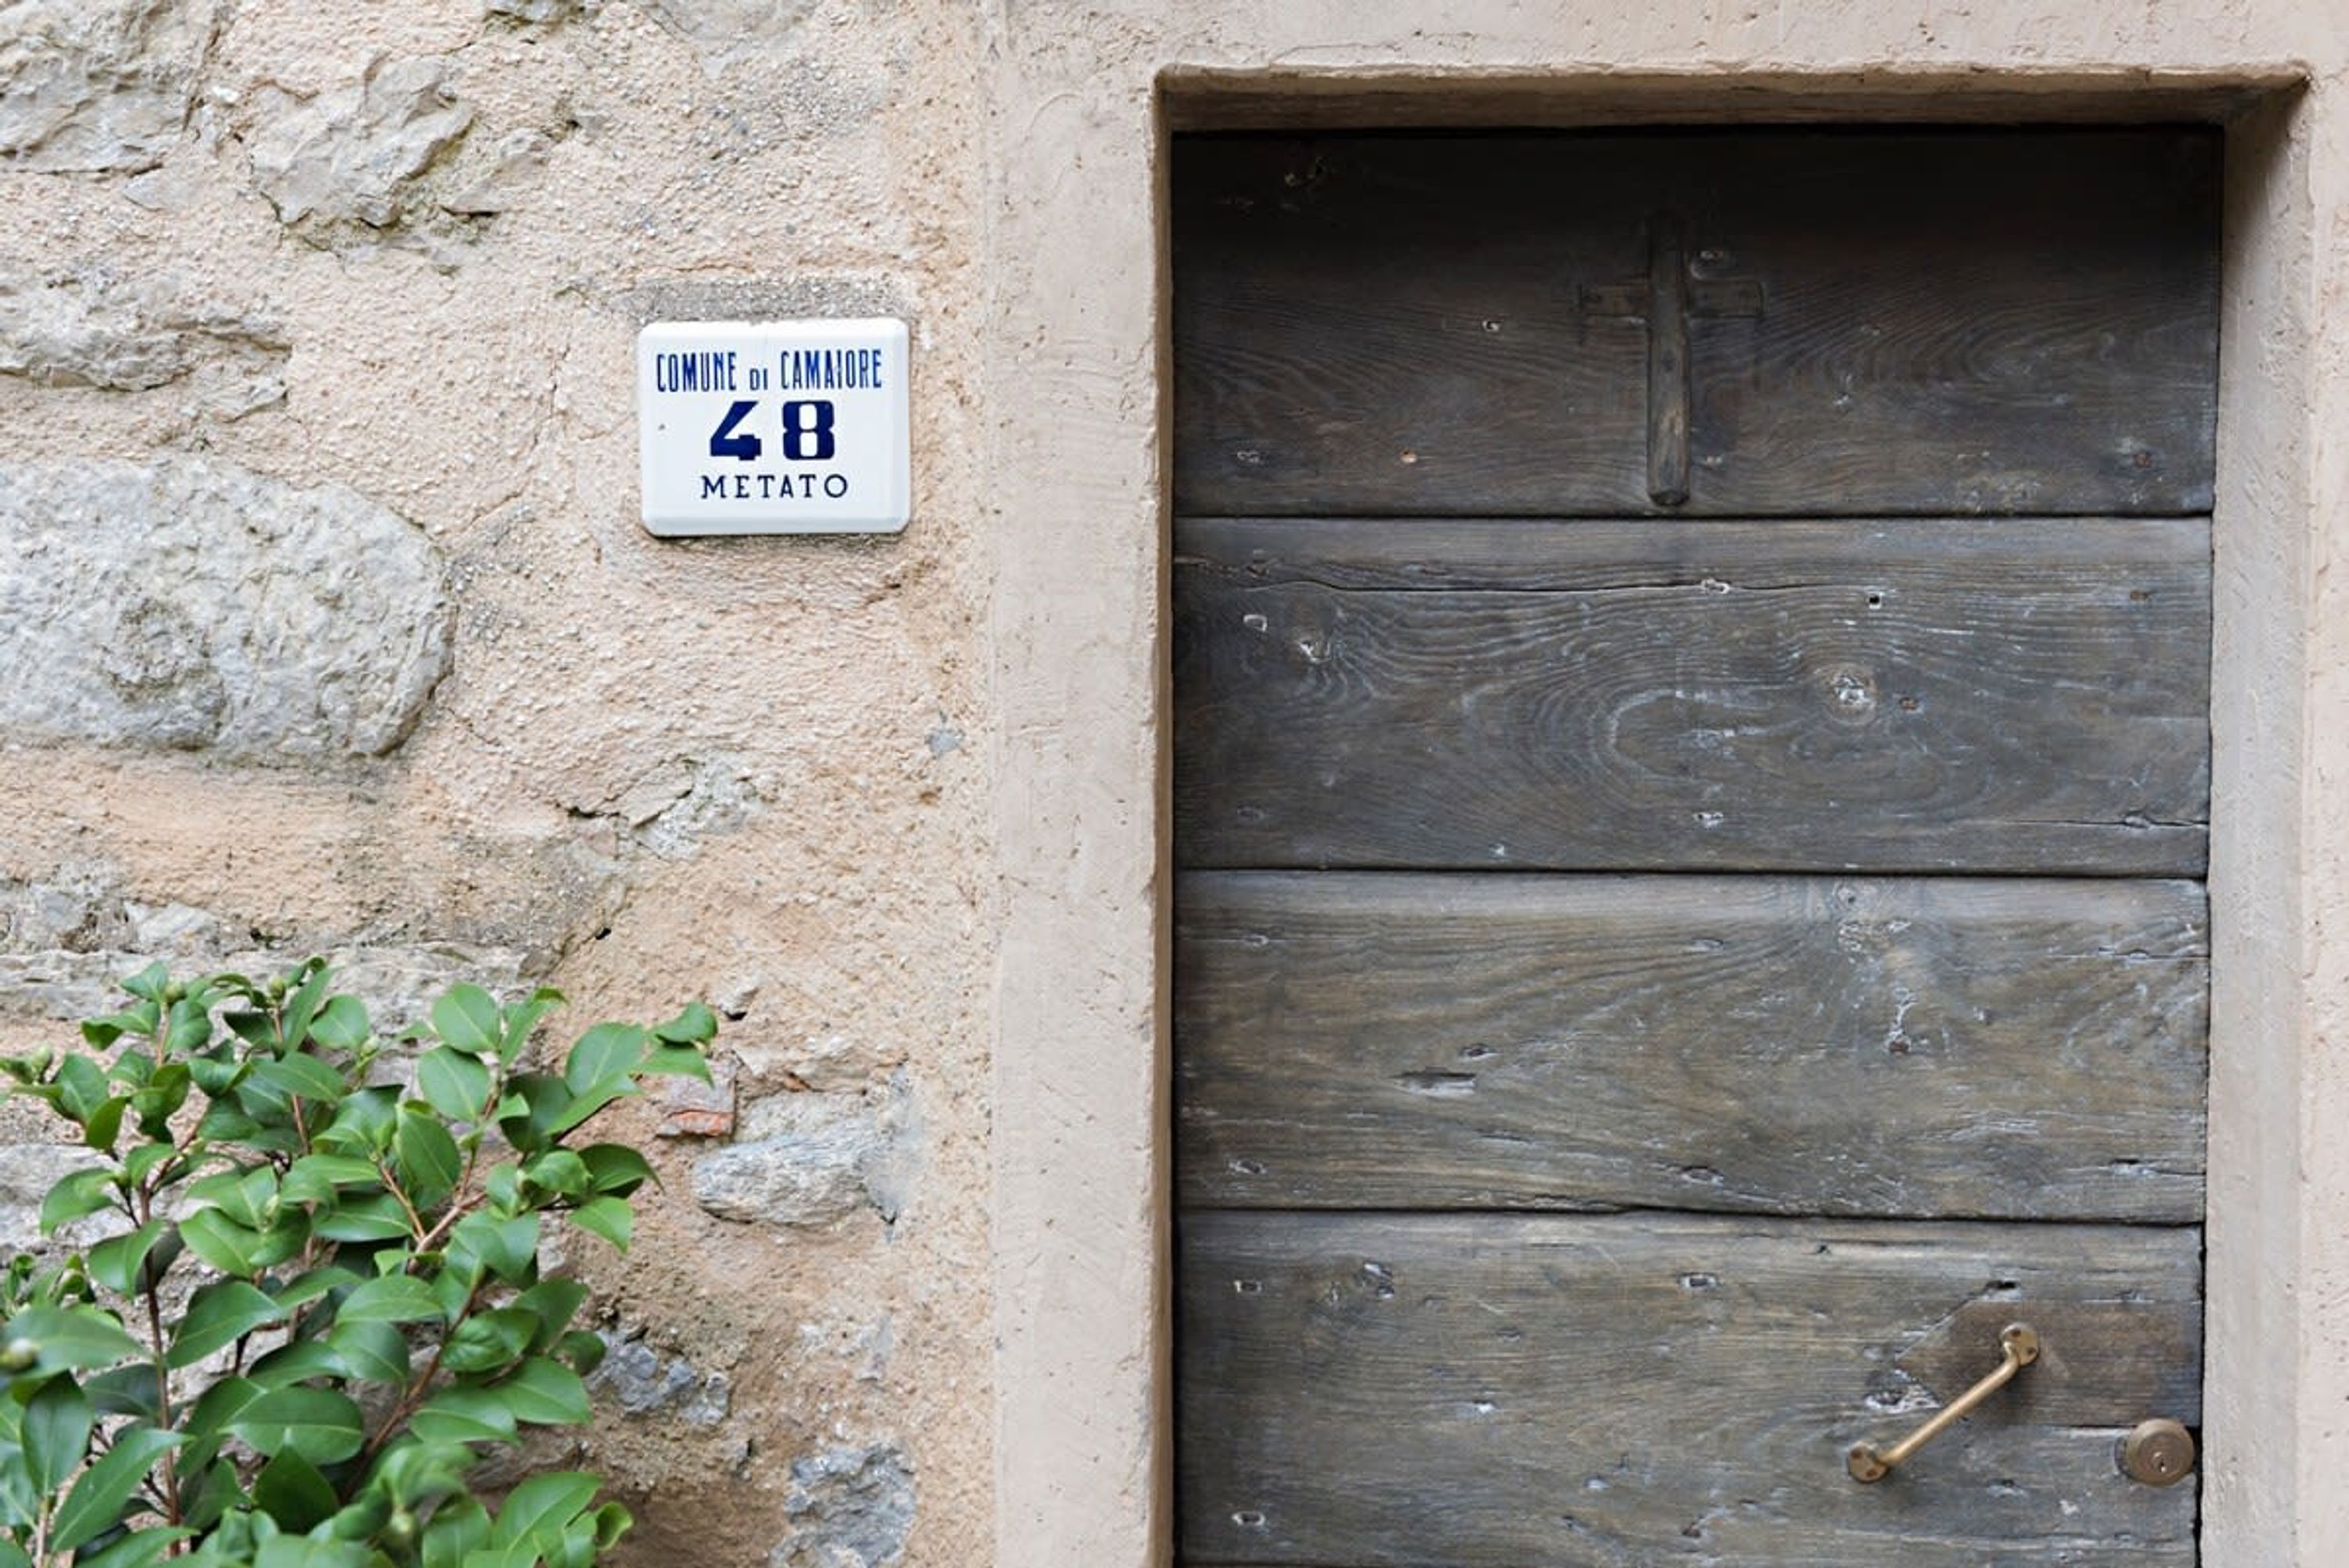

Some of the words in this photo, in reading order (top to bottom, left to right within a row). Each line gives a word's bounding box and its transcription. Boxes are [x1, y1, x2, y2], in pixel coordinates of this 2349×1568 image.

[656, 351, 737, 393] COMUNE
[781, 349, 882, 390] CAMAIORE
[709, 400, 835, 461] 48
[701, 474, 848, 499] METATO
